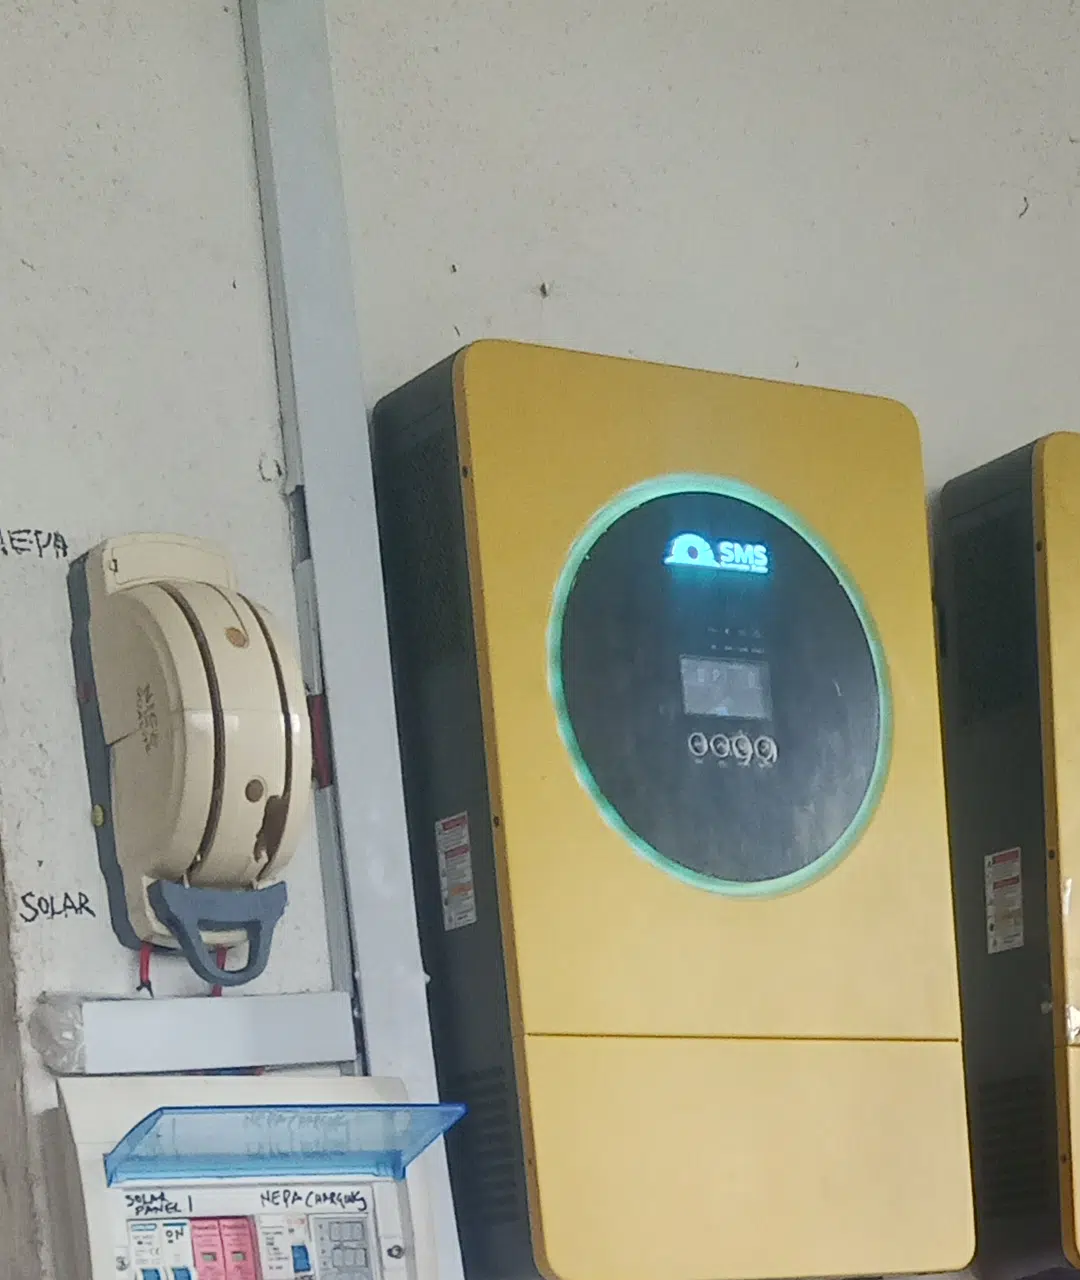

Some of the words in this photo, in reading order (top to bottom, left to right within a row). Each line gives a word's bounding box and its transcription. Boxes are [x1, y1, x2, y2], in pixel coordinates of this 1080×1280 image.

[719, 540, 769, 566] SMS
[20, 892, 96, 922] SOLAR
[260, 1189, 303, 1208] NEPA
